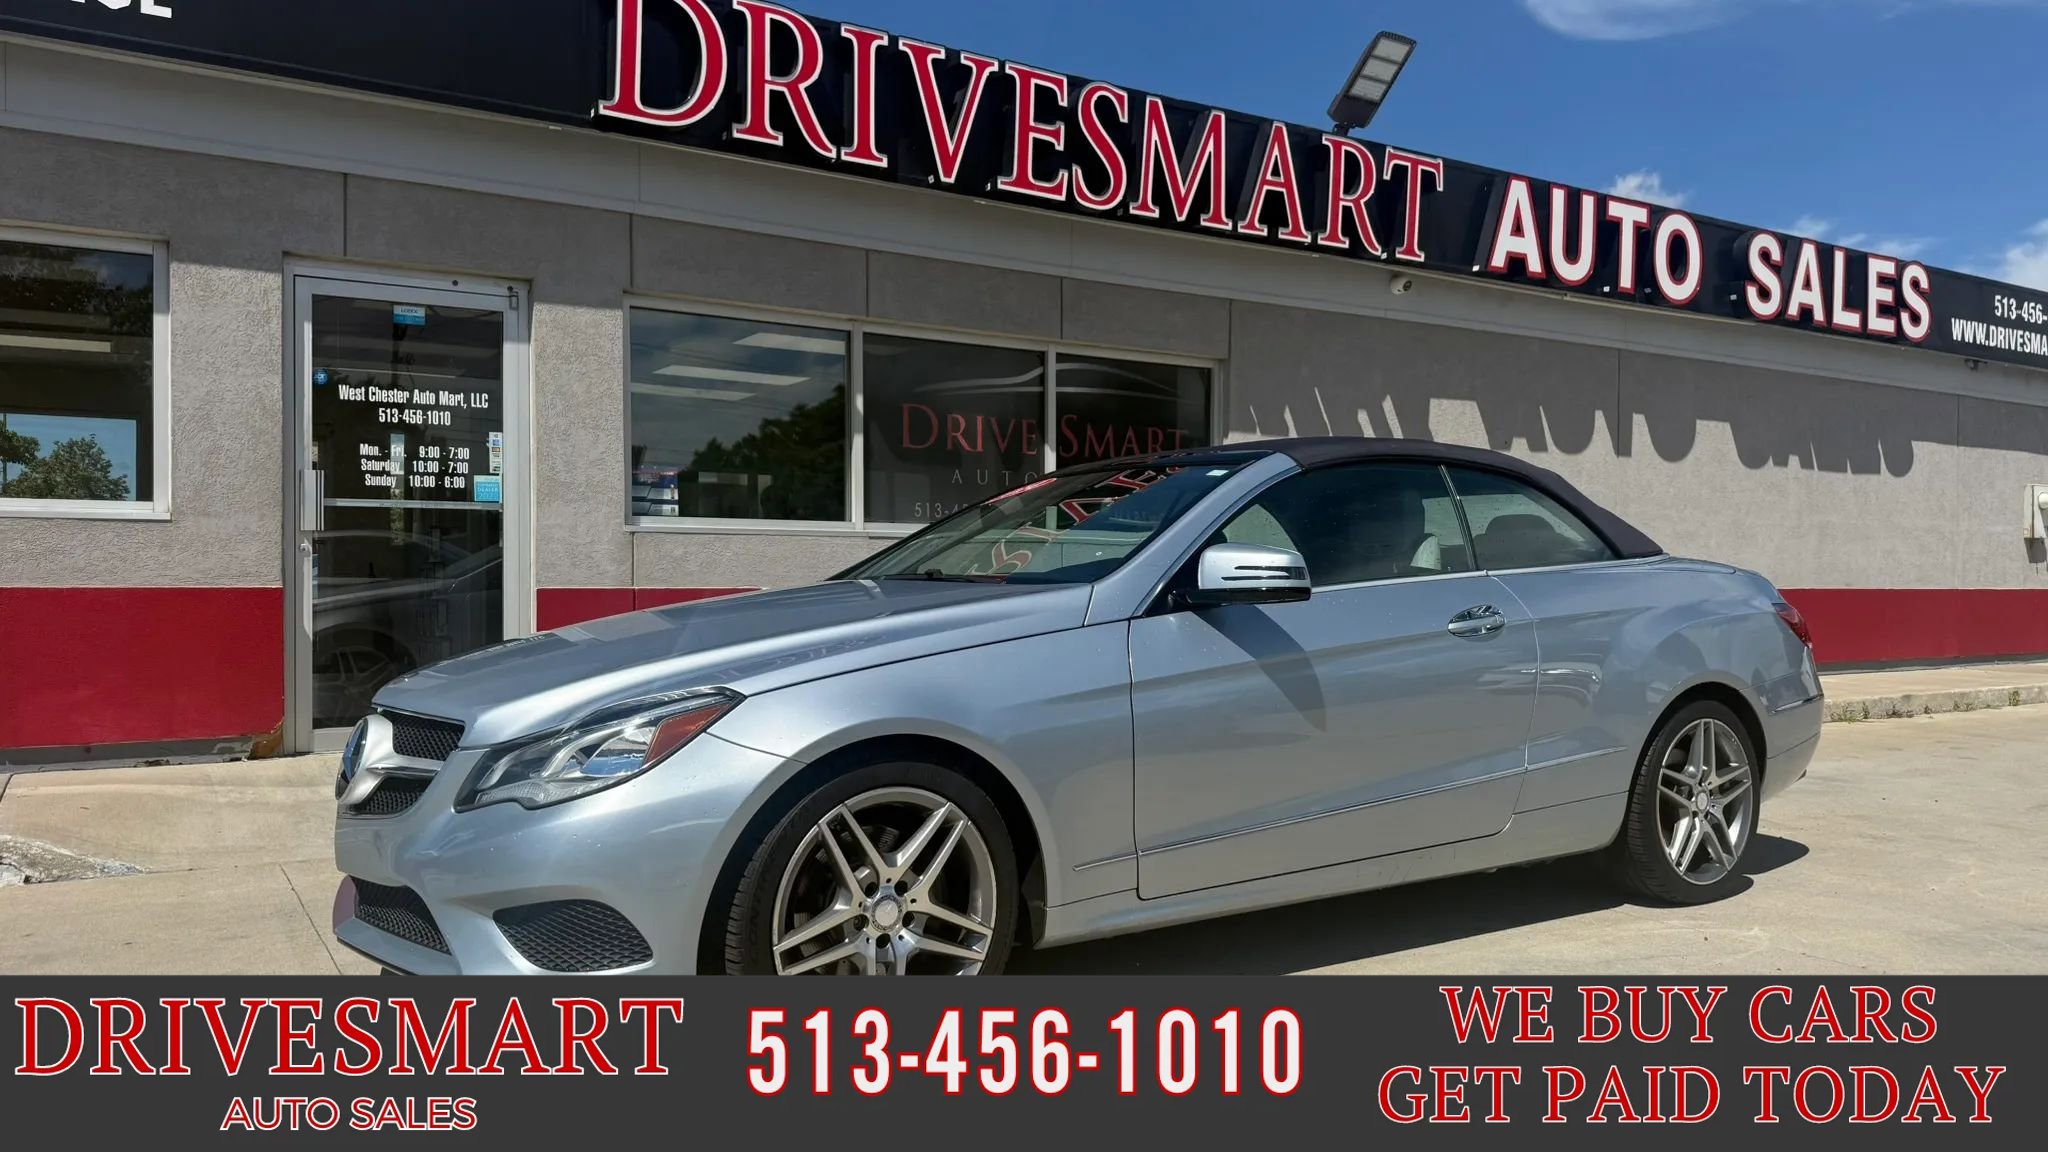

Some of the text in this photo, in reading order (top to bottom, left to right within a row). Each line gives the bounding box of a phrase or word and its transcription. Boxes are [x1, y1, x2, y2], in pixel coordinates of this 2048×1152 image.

[598, 0, 1933, 344] DRIVESMART AUTO SALES
[338, 384, 489, 409] West Chester Auto Mart, LLC
[378, 407, 451, 426] 513-456-1010
[901, 402, 1190, 458] DRIVE SMART
[359, 443, 382, 456] Mon.
[391, 444, 407, 458] Fri.
[419, 445, 440, 458] 9:00
[448, 446, 470, 460] 7:00
[361, 458, 401, 473] Saturday
[412, 460, 439, 473] 10:00
[448, 461, 469, 474] 7:00
[365, 473, 397, 488] Sunday
[409, 474, 436, 488] 10:00
[444, 475, 466, 488] 6:00
